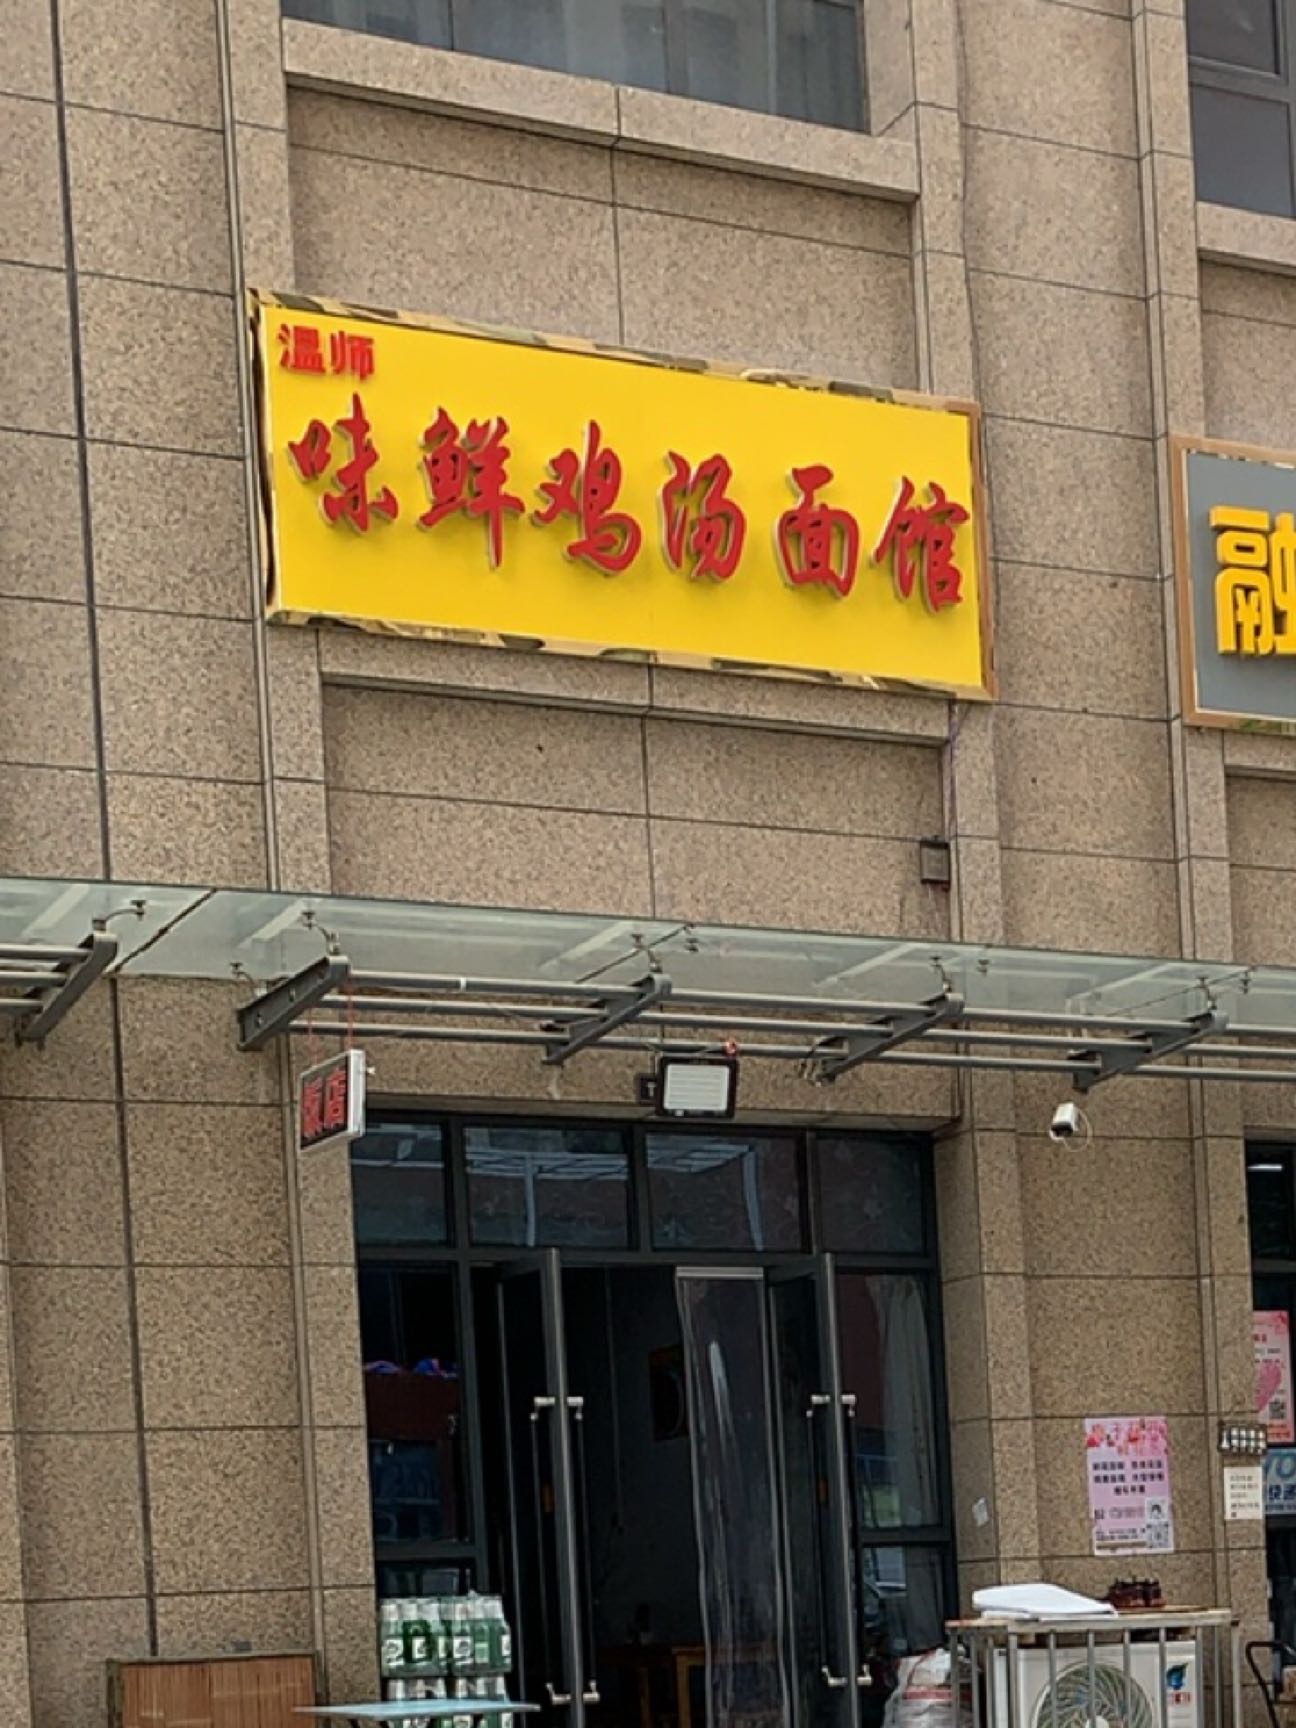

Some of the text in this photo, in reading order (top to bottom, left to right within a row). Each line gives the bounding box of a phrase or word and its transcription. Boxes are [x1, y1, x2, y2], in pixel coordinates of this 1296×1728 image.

[275, 321, 376, 382] 温师
[286, 392, 972, 614] 味鲜鸡汤面馆
